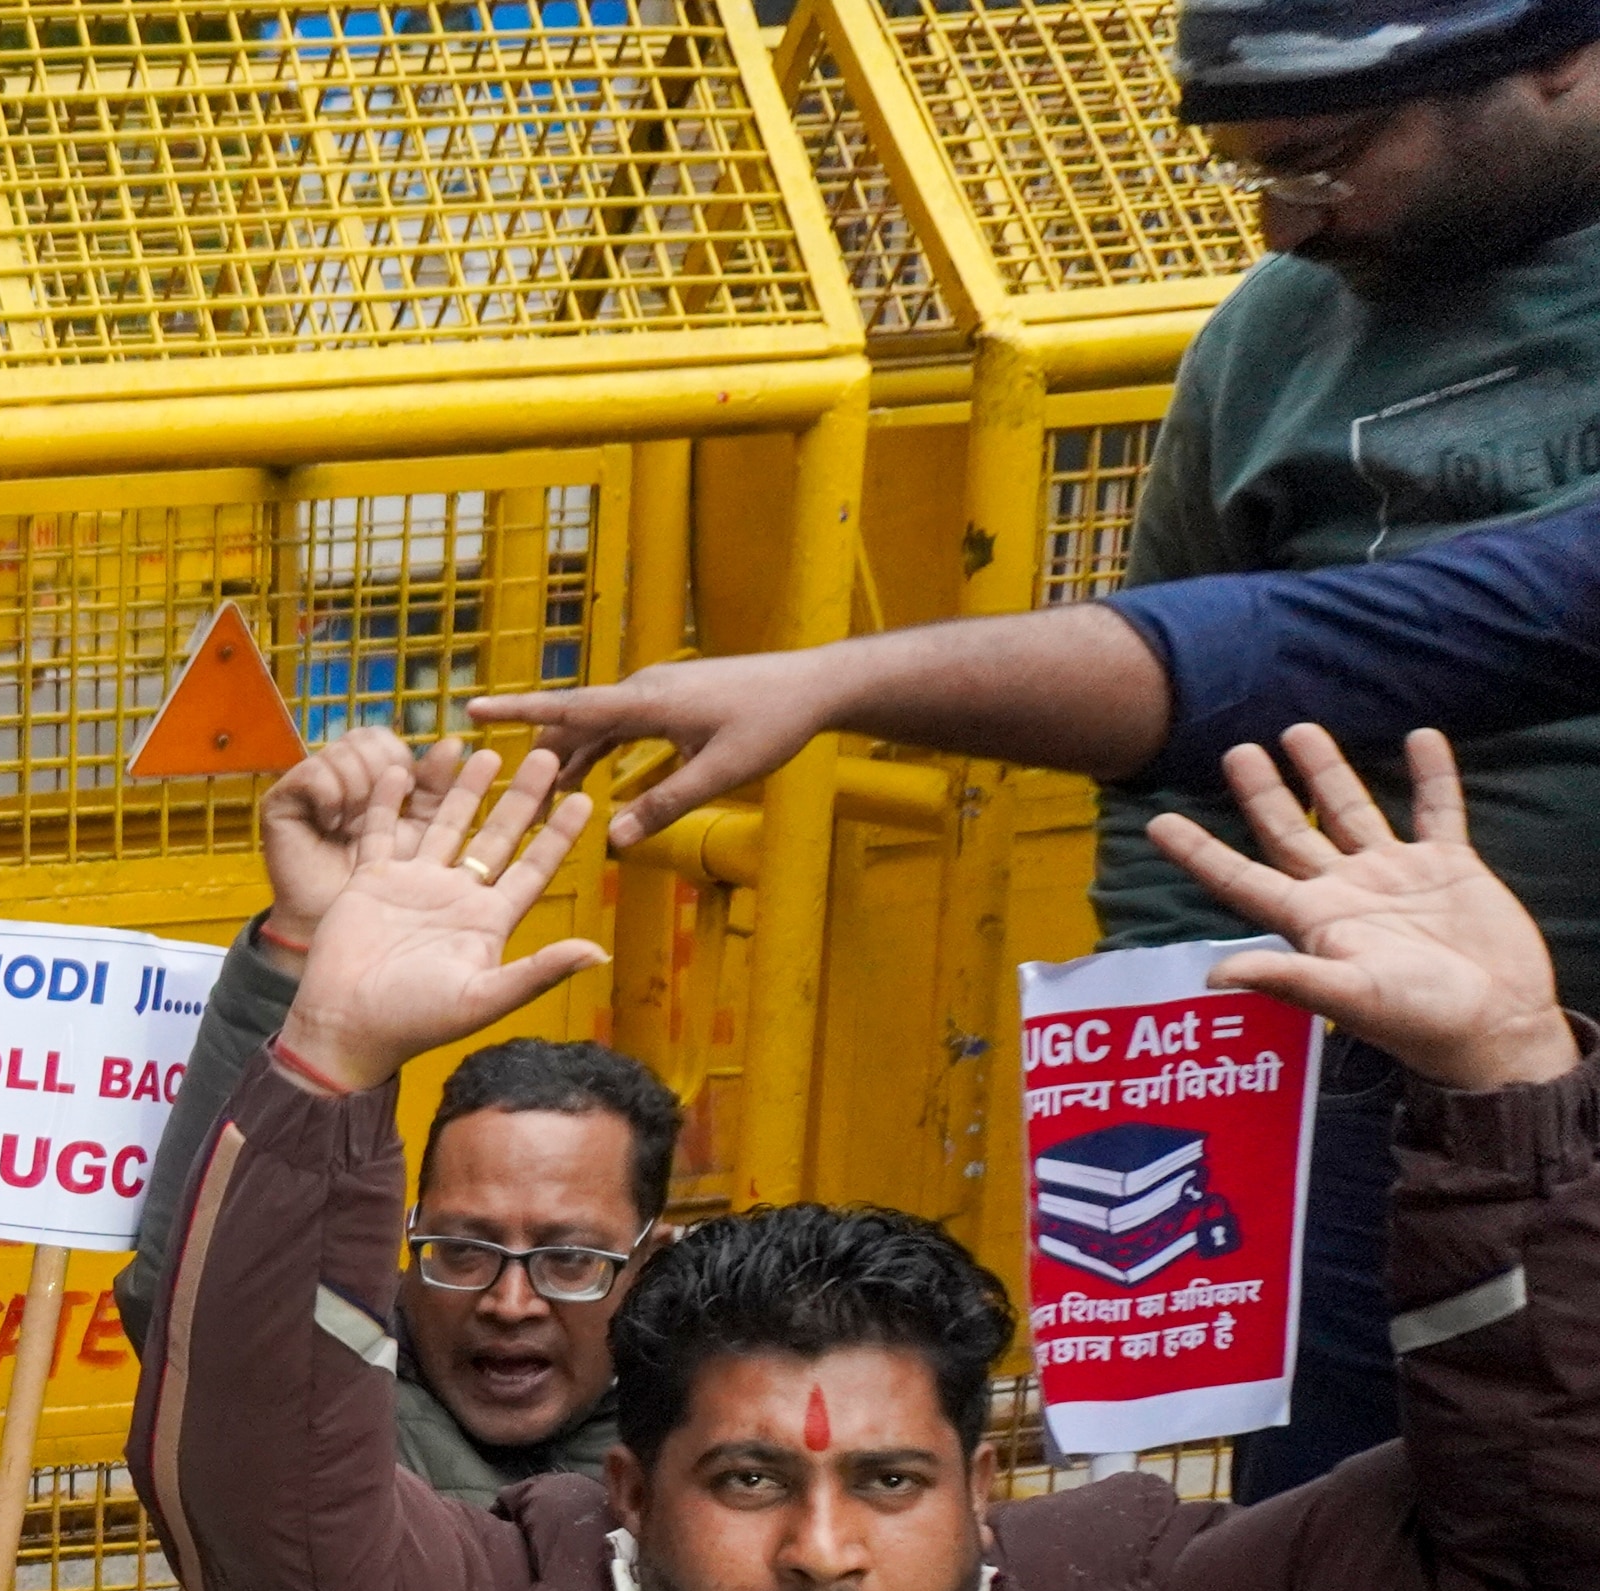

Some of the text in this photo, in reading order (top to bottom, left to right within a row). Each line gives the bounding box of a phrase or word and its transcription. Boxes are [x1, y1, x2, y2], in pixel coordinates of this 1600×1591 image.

[1124, 1010, 1200, 1060] Act
[1121, 1063, 1174, 1108] वर्ग
[1176, 1050, 1284, 1102] विरोधी
[0, 1133, 148, 1198] UGC
[1119, 1331, 1161, 1360] का
[1212, 1311, 1237, 1349] है
